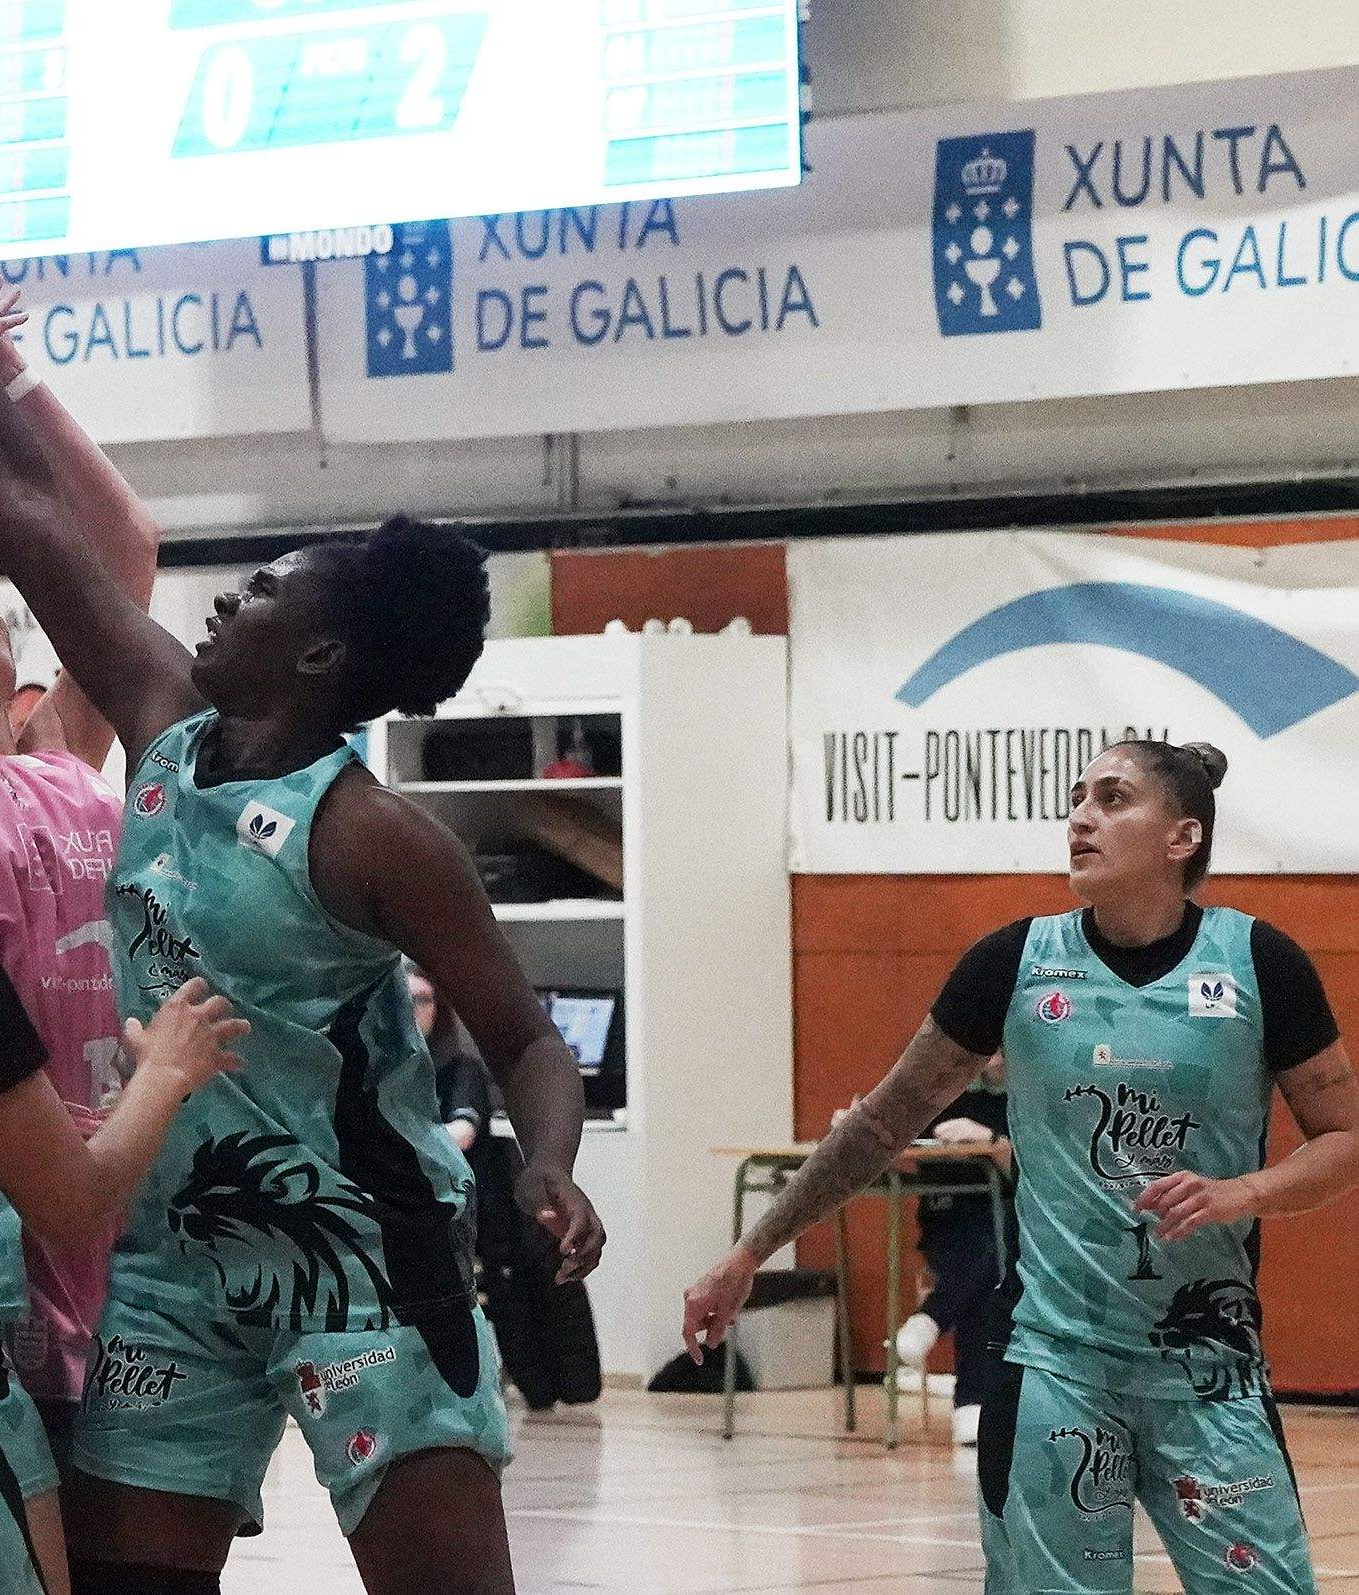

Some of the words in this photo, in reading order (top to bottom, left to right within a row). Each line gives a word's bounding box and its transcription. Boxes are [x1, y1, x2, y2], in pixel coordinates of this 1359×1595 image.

[396, 23, 446, 128] 2
[1060, 122, 1308, 213] XUNTA
[1062, 234, 1152, 308] DE
[1175, 211, 1359, 299] GALIC
[43, 291, 264, 367] GALICIA
[475, 284, 551, 352] DE
[568, 263, 821, 346] GALICIA
[823, 724, 1169, 824] VISIT-PONTEVEDR
[1030, 965, 1087, 980] Kromex
[1107, 1109, 1202, 1152] Pellet
[1117, 1083, 1160, 1114] mi
[97, 1356, 187, 1400] Pellet
[321, 1347, 396, 1382] universidad
